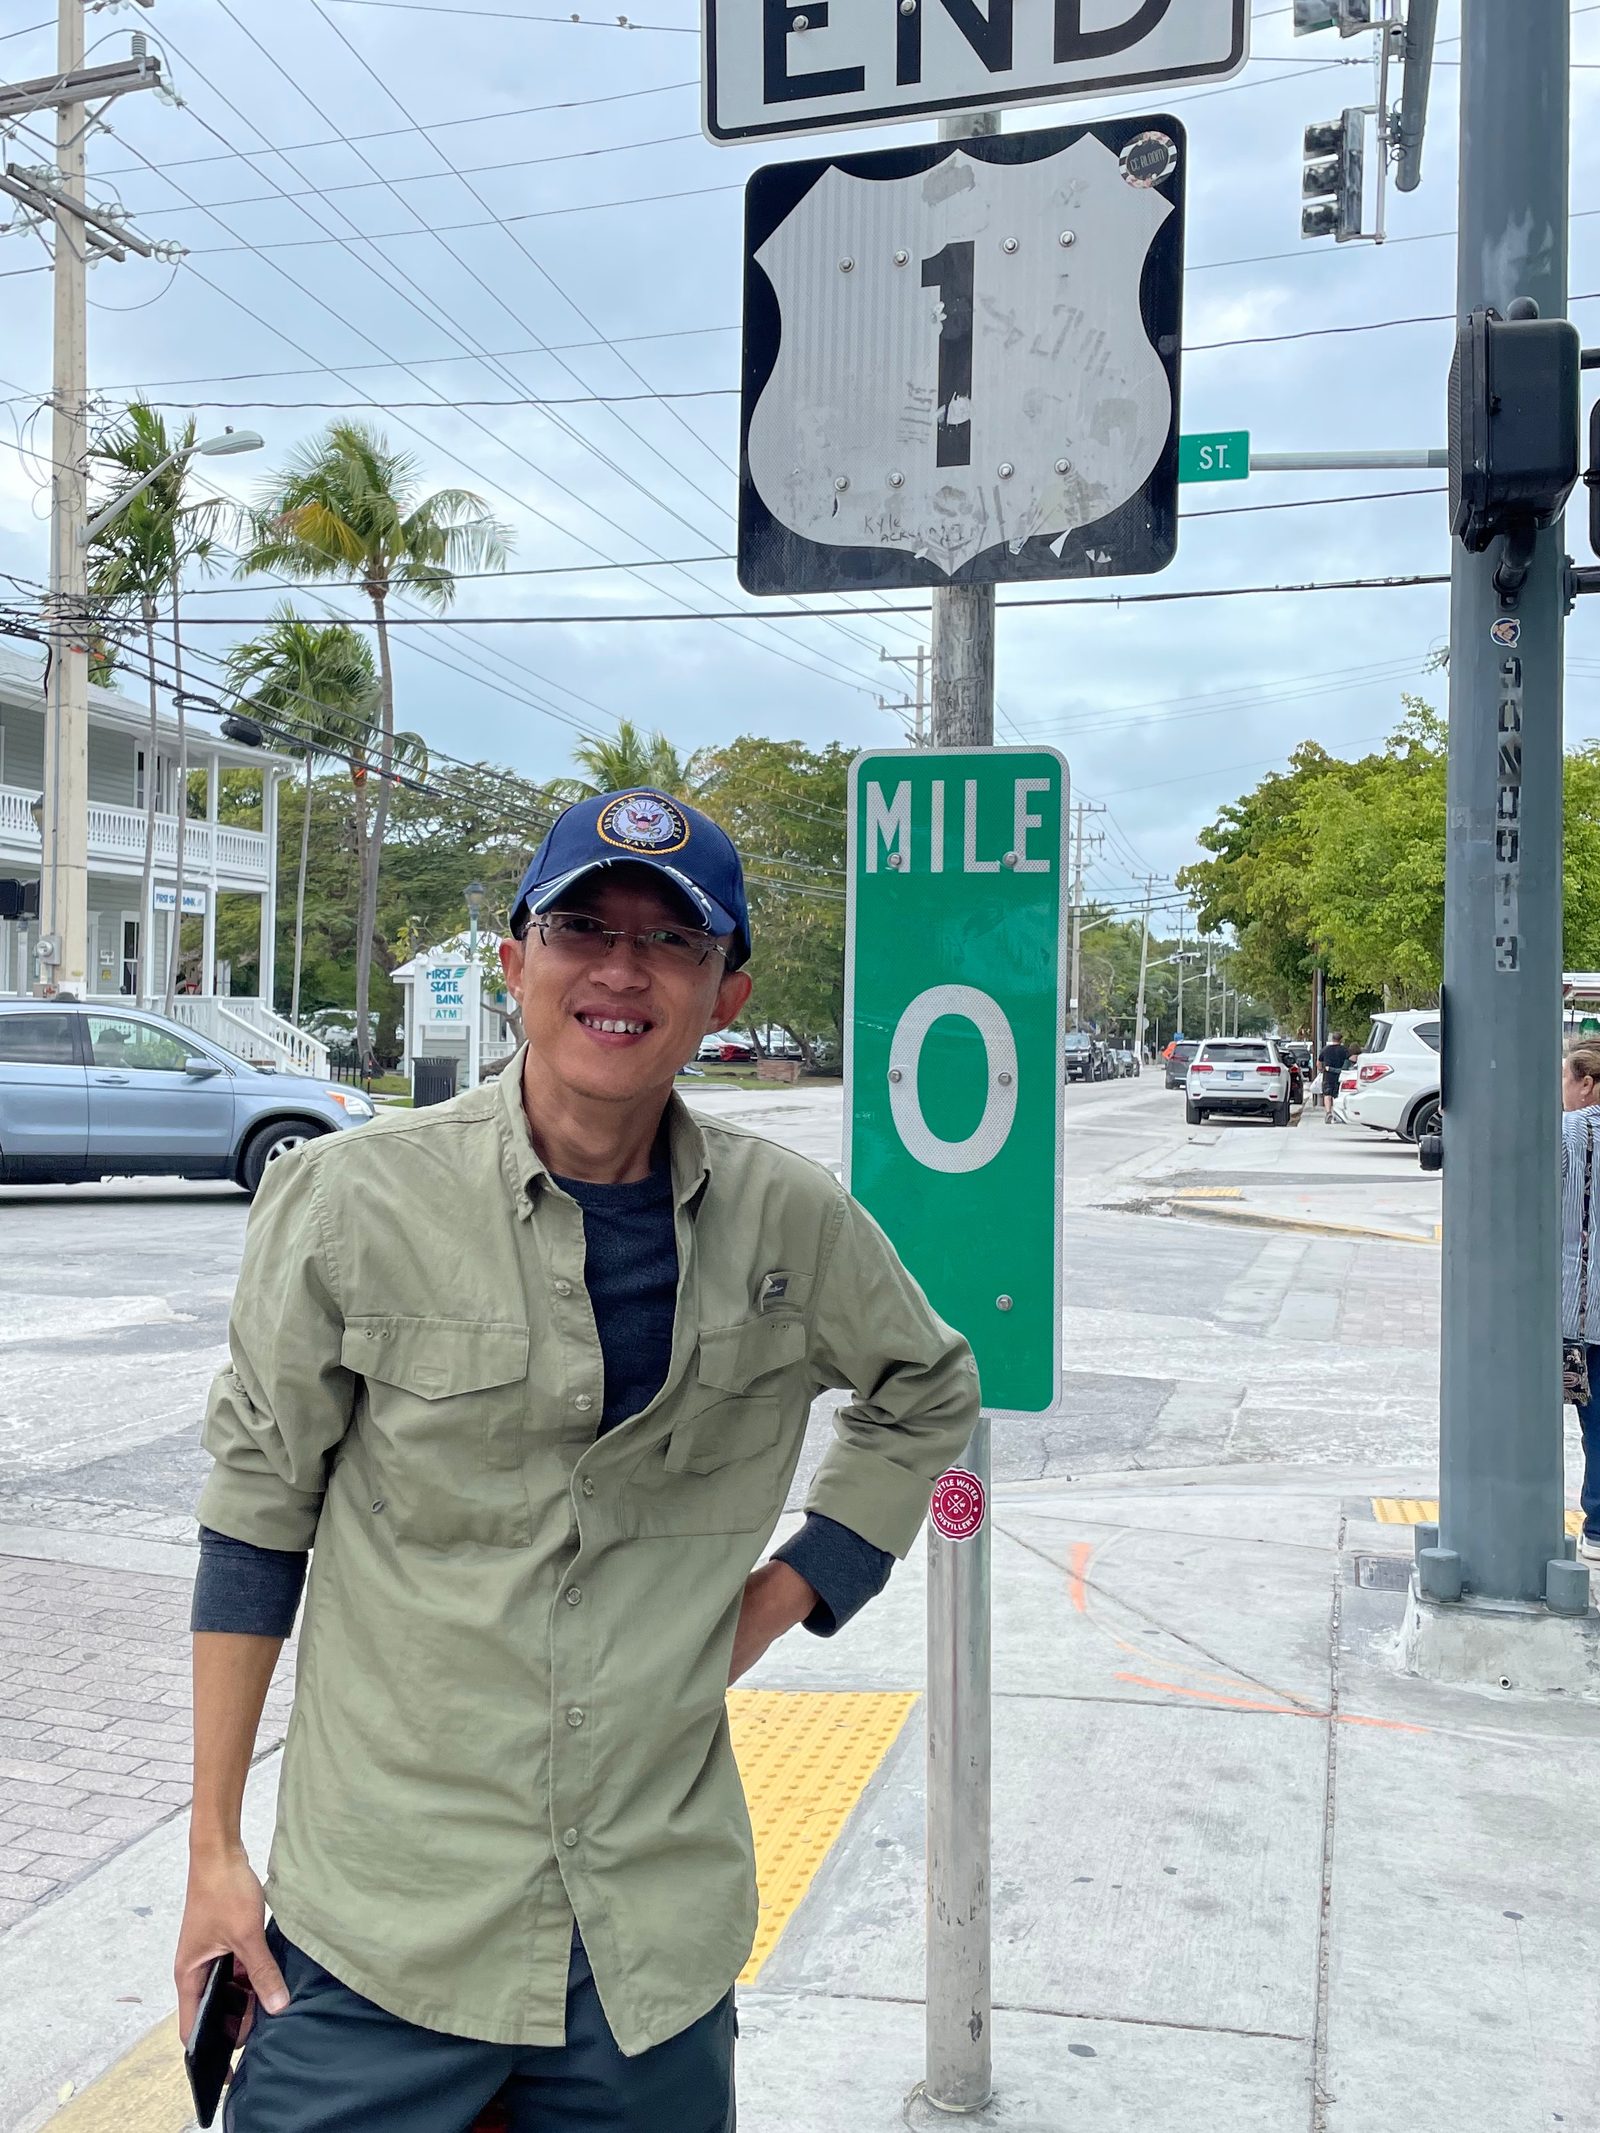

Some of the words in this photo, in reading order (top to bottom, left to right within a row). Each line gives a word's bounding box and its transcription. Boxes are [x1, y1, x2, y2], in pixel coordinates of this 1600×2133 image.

[920, 240, 975, 468] 1
[1199, 444, 1231, 470] ST.
[603, 797, 636, 830] UNITED
[660, 801, 682, 840] STATES
[865, 777, 1051, 874] MILE
[623, 838, 656, 849] NAVY
[430, 981, 458, 992] STATE
[436, 994, 464, 1005] BANK
[435, 1009, 457, 1018] ATM
[888, 983, 1019, 1174] 0
[934, 1478, 955, 1498] LITTLE
[956, 1478, 979, 1501] WATER
[936, 1512, 975, 1531] DISTILLERY
